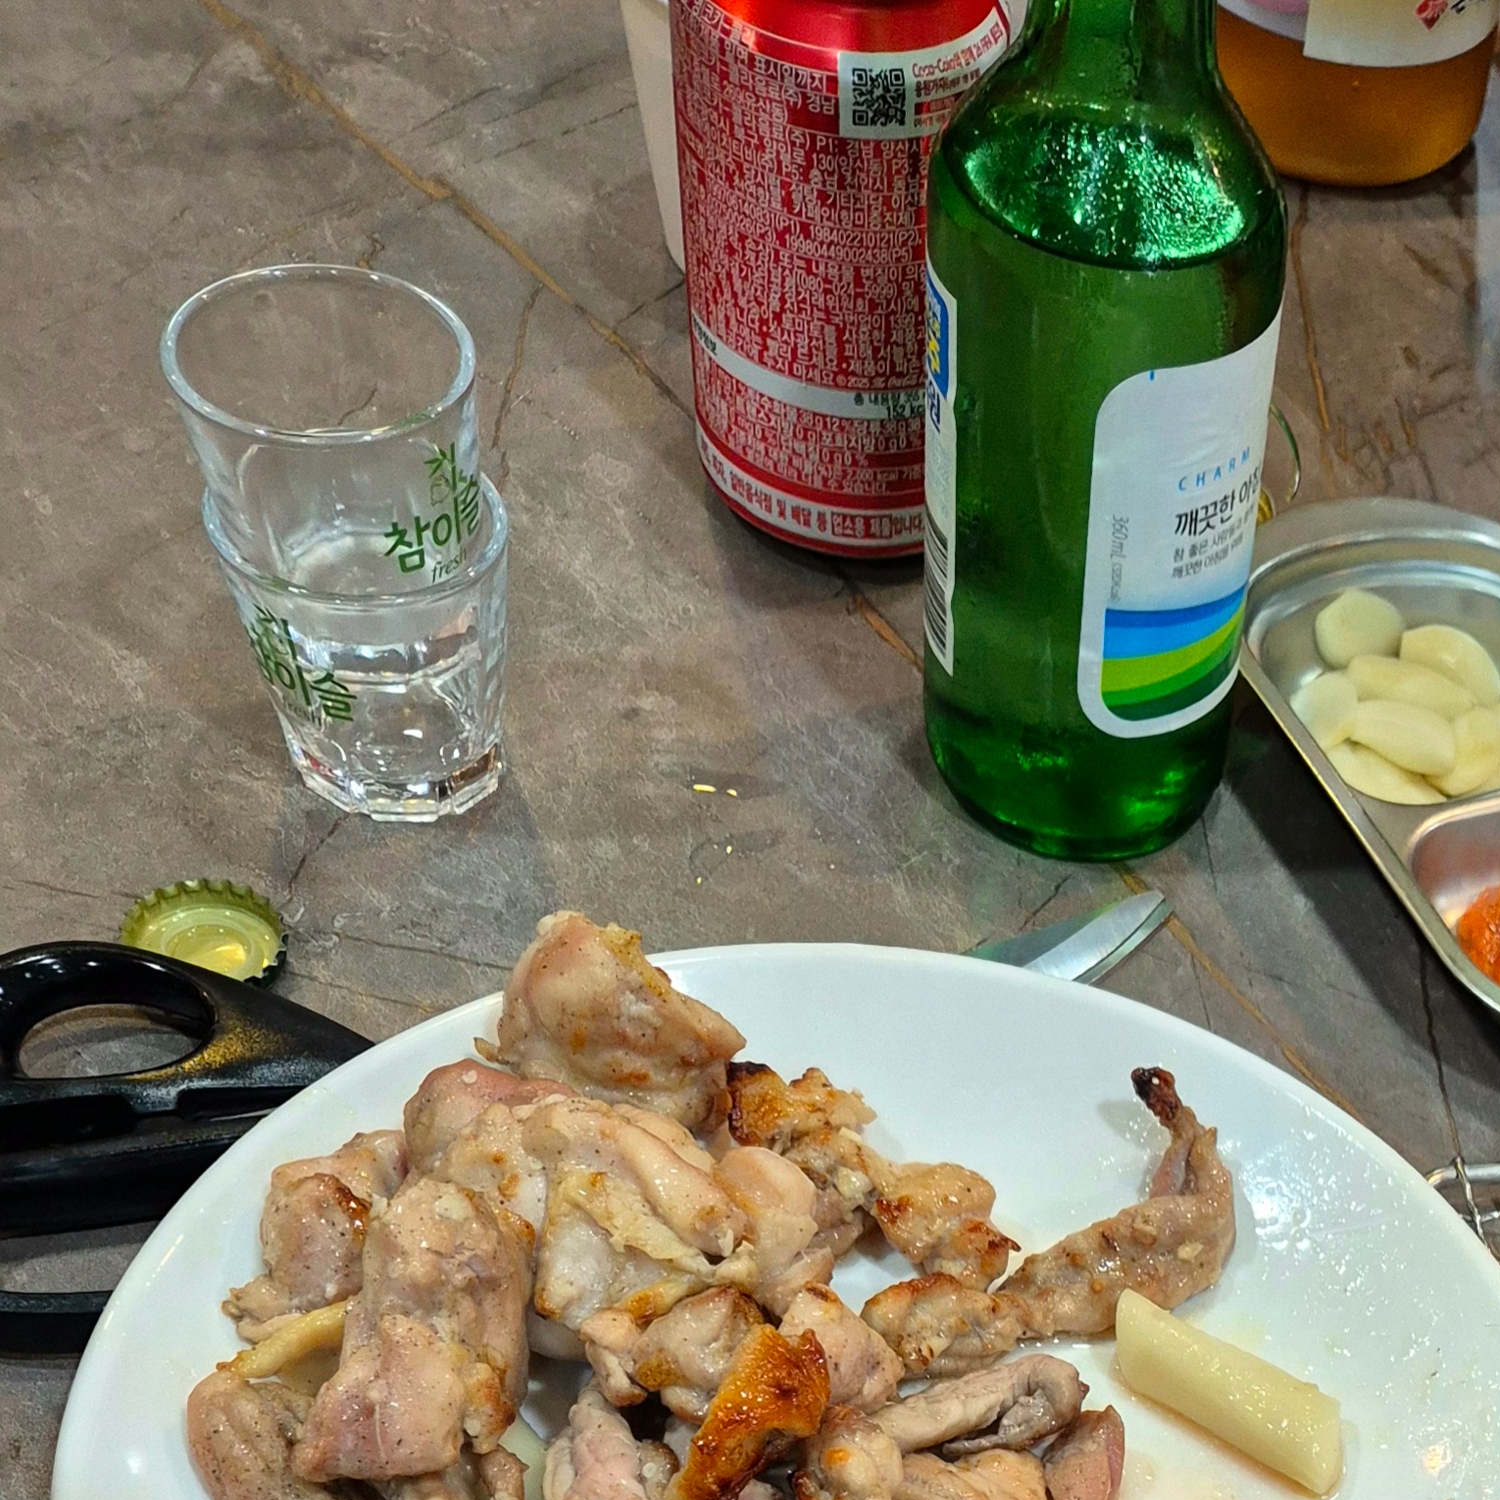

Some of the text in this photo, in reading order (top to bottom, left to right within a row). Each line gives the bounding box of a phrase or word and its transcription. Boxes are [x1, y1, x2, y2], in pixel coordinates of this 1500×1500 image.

[751, 51, 827, 94] 표시일까지
[805, 92, 837, 116] 경남
[815, 134, 839, 157] P1:
[845, 138, 874, 158] 경남
[888, 306, 915, 328] 1399
[886, 404, 907, 420] 152
[1177, 446, 1252, 492] CHARM
[383, 441, 481, 574] 참이슬
[1174, 488, 1237, 538] 깨끗한
[431, 547, 468, 584] fresh
